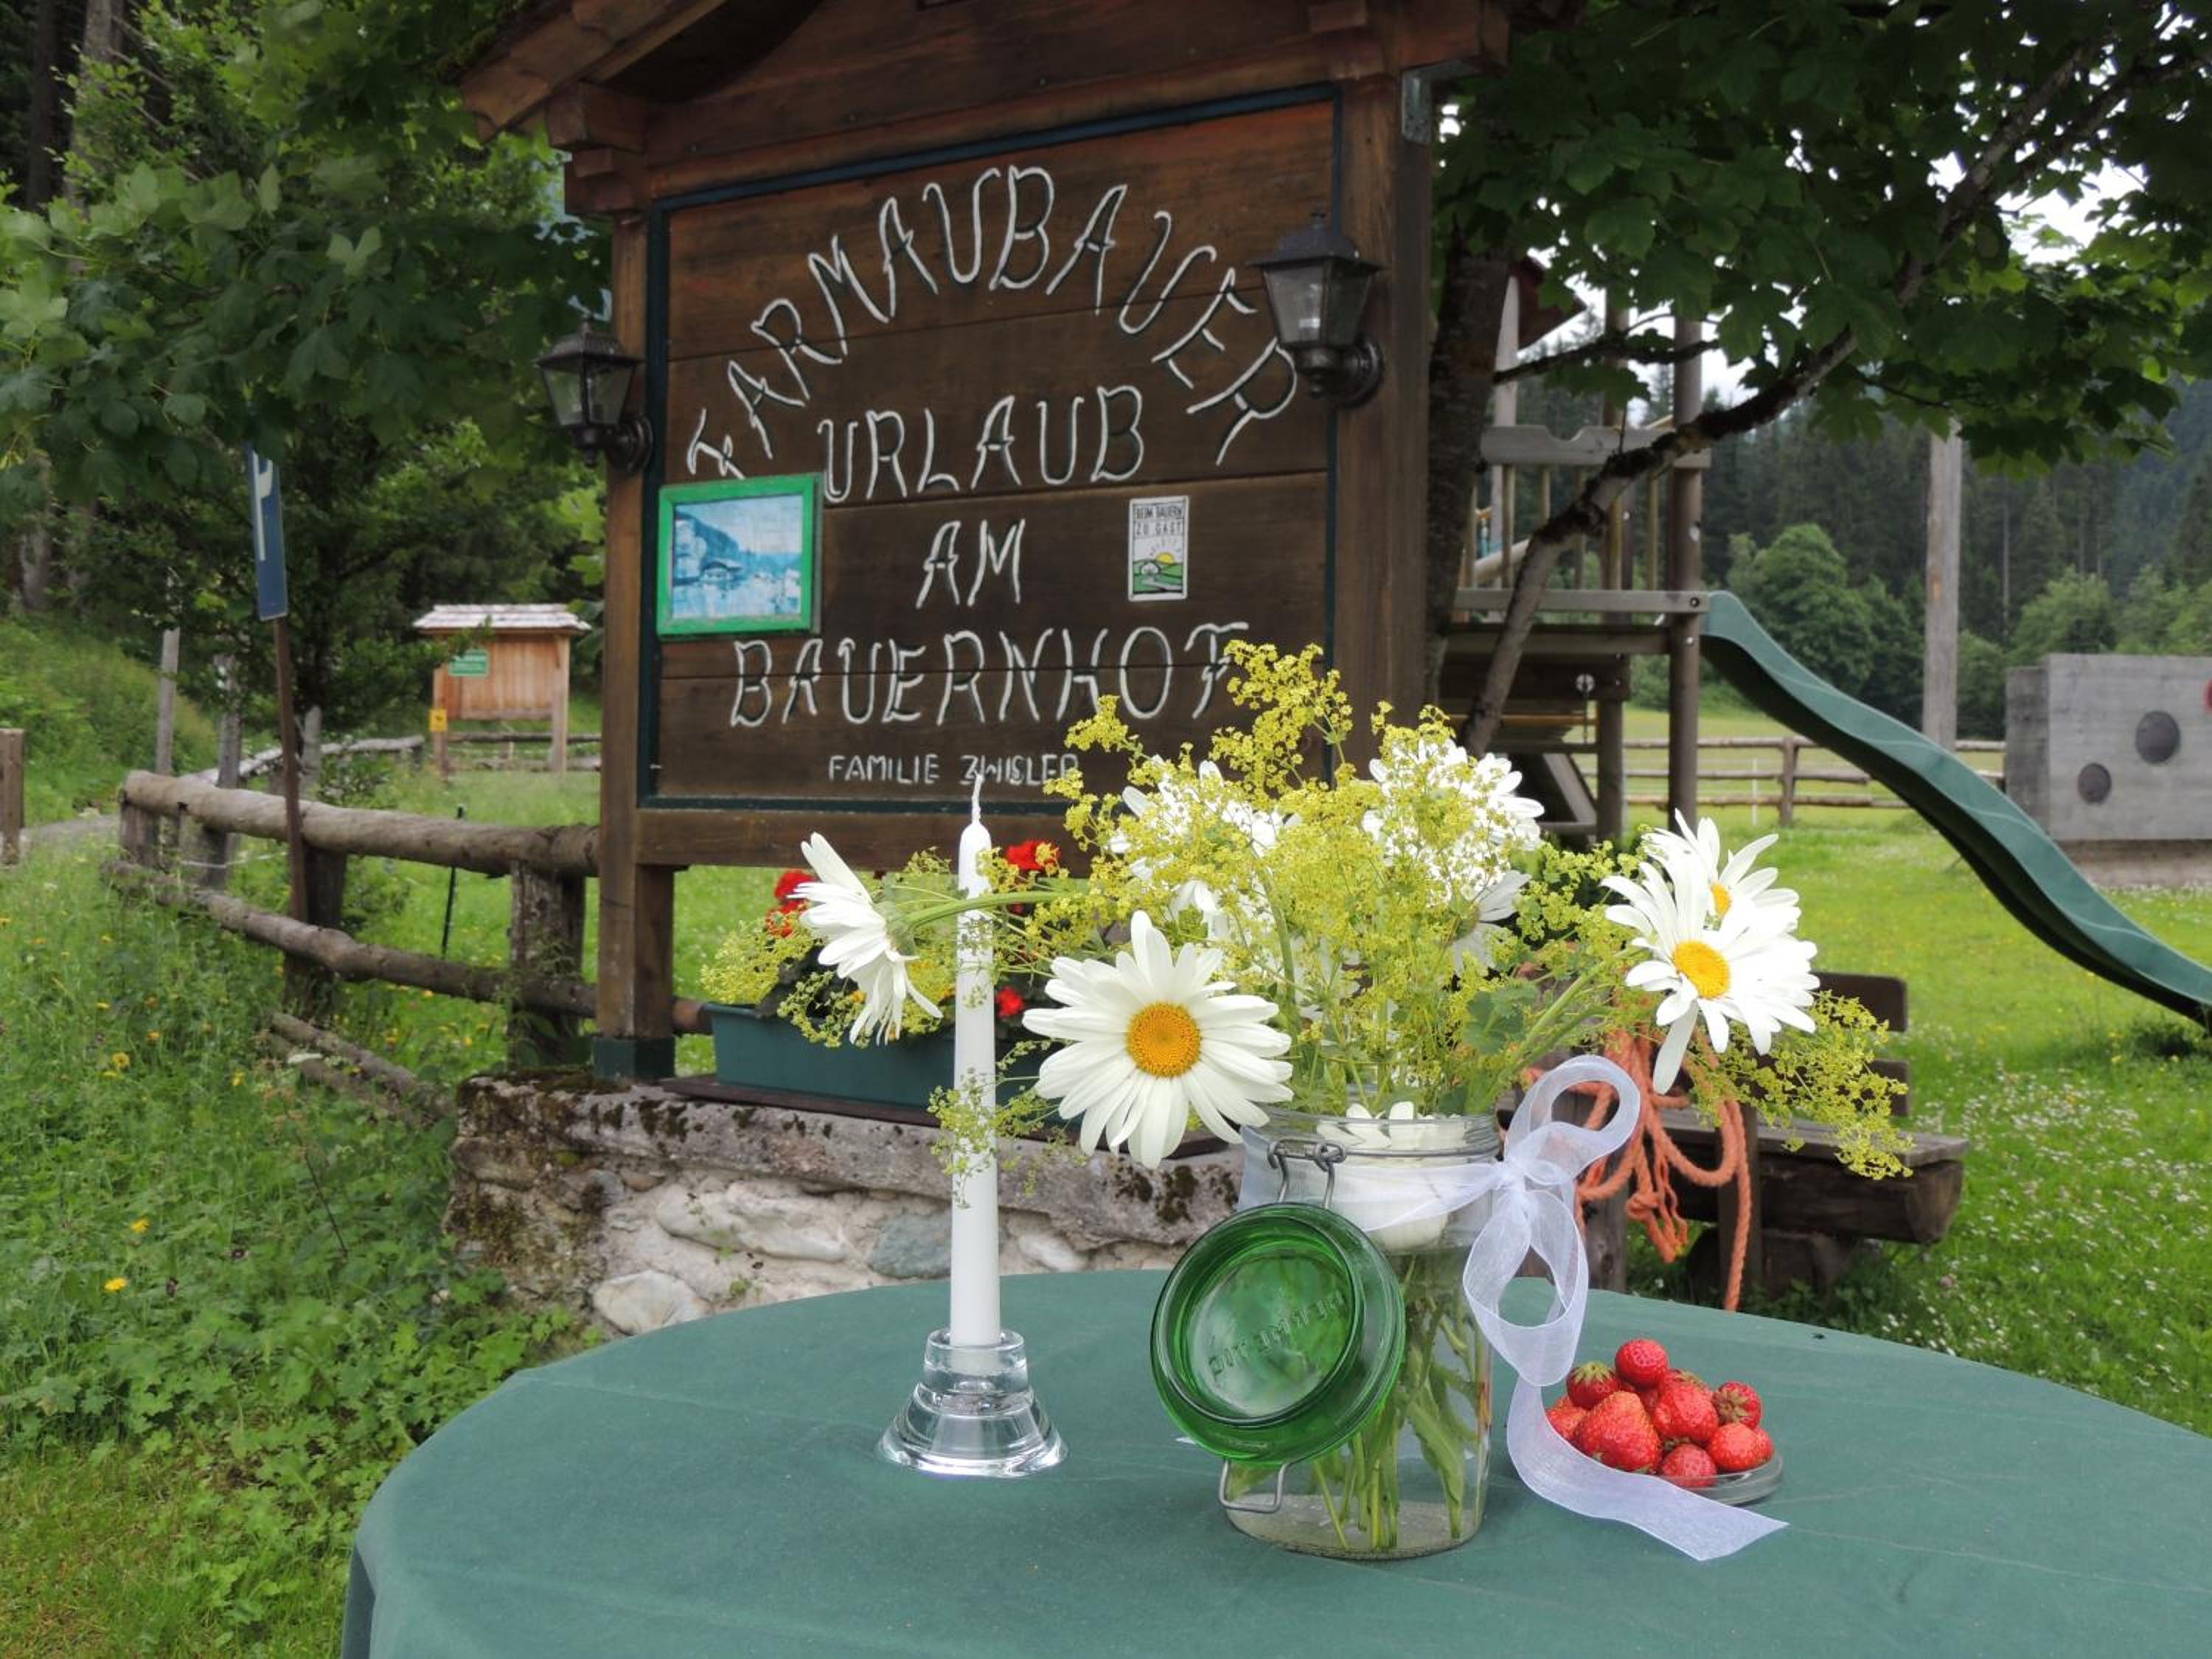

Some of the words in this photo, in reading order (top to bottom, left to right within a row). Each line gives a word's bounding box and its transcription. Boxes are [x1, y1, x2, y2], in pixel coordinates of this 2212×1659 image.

[818, 386, 1144, 503] URLAUB
[916, 518, 1026, 608] AM
[730, 621, 1249, 728] BAUERNHOF
[828, 754, 939, 785] FAMILIE
